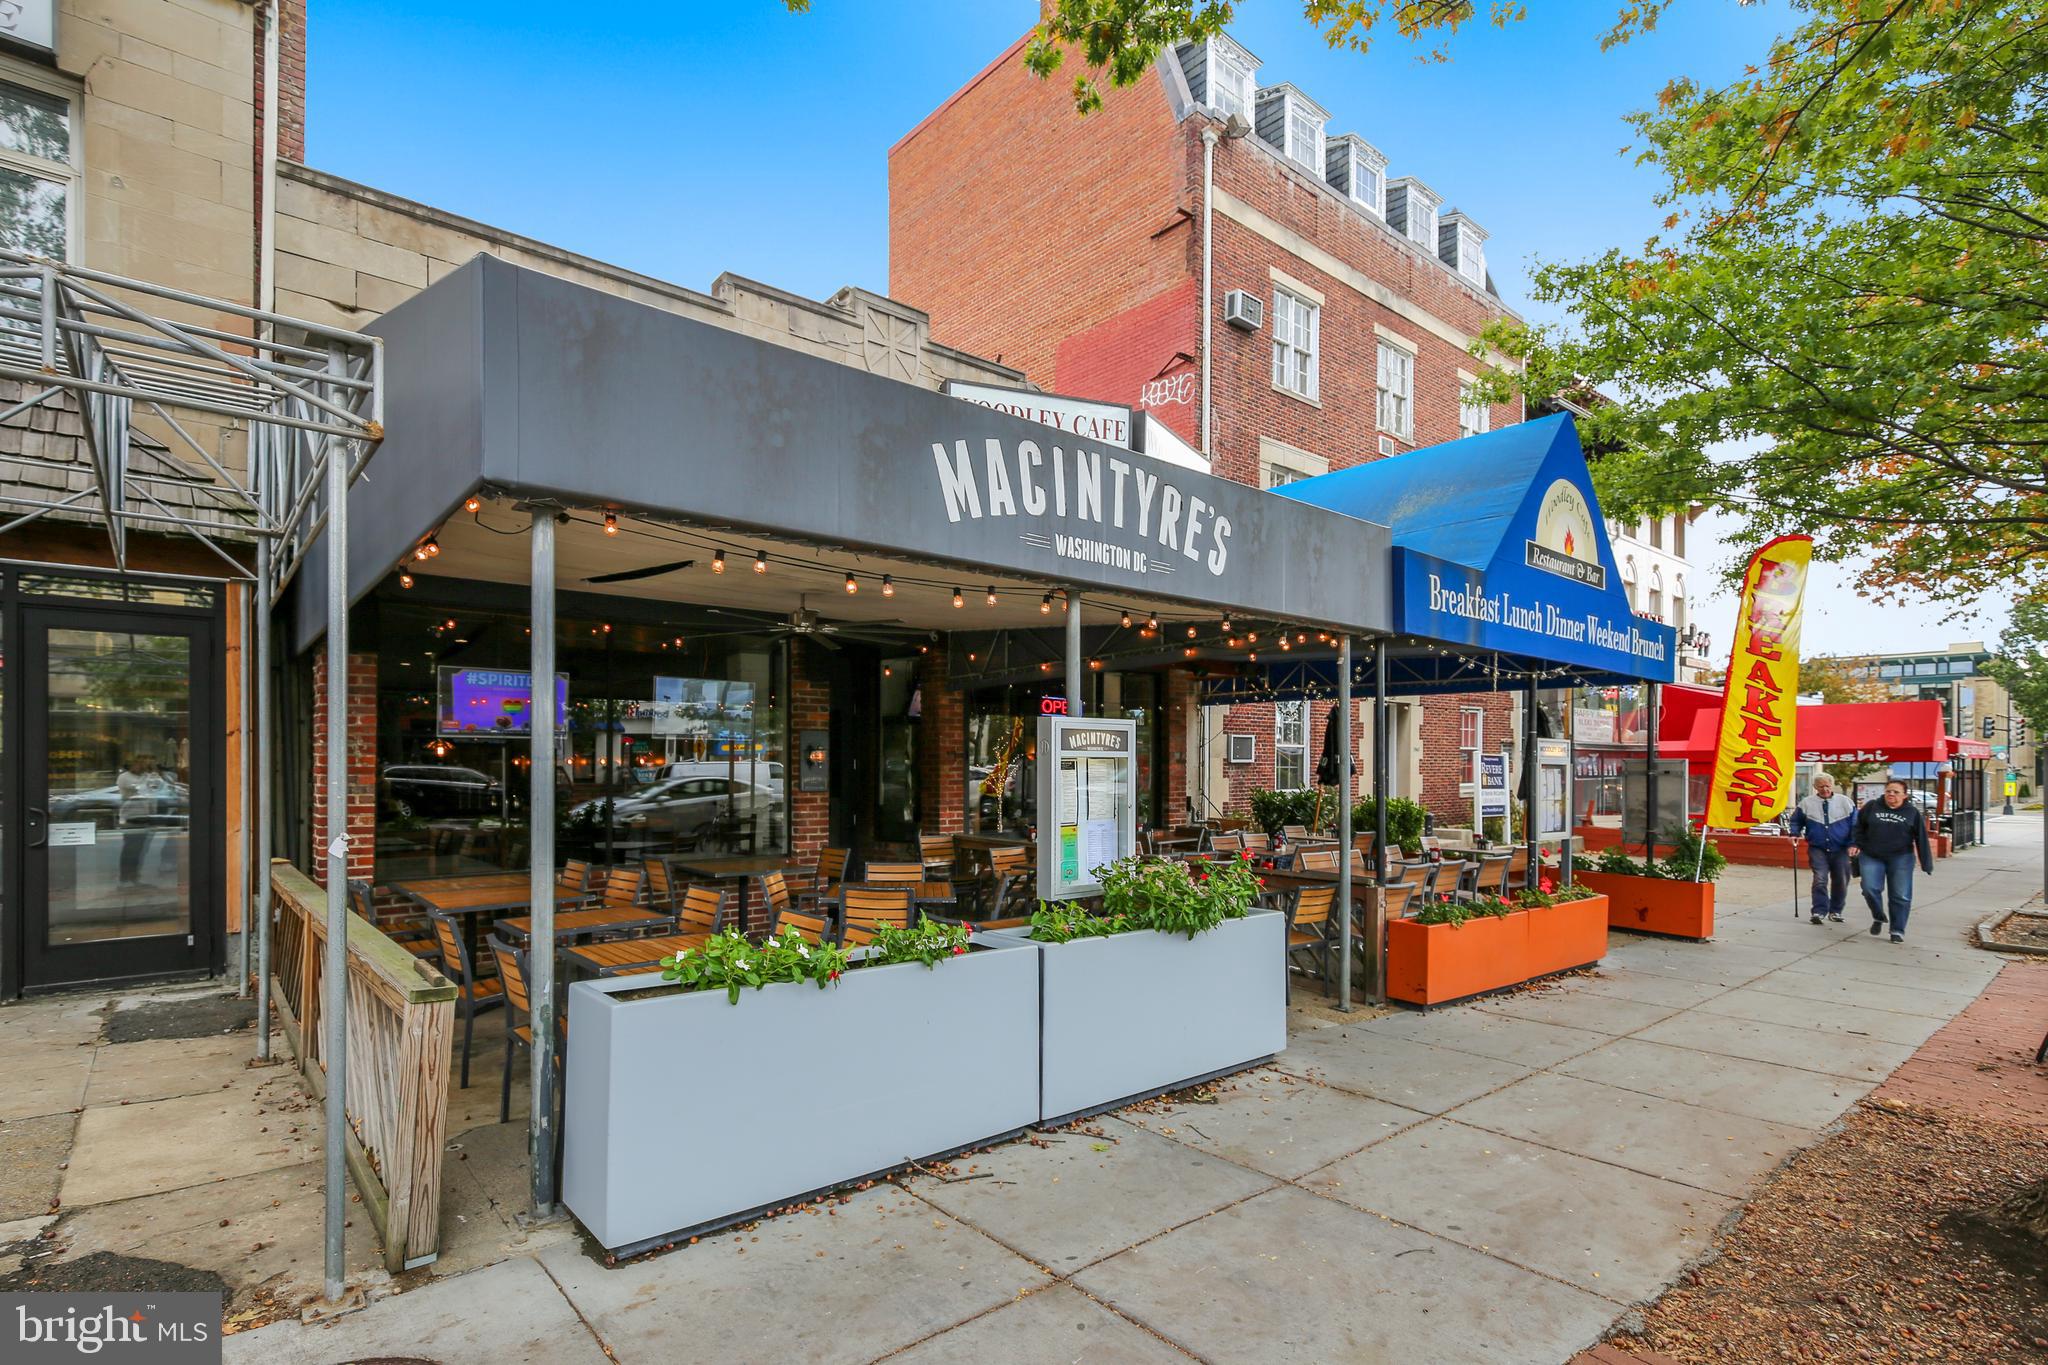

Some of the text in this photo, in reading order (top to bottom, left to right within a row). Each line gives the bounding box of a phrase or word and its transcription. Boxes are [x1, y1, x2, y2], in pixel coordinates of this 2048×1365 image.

[1073, 415, 1126, 442] CAFE
[932, 438, 1232, 576] MACINTYRE'S
[1055, 533, 1147, 574] WASHINGTON DC
[1533, 547, 1601, 583] Restaurant & Bar
[1428, 574, 1665, 661] Breakfast Lunch Dinner Weekend Brunch
[1068, 731, 1121, 750] MACINTYRE'S
[1481, 762, 1503, 774] REVERE
[1799, 750, 1889, 762] Sushi
[1488, 776, 1503, 786] BANK
